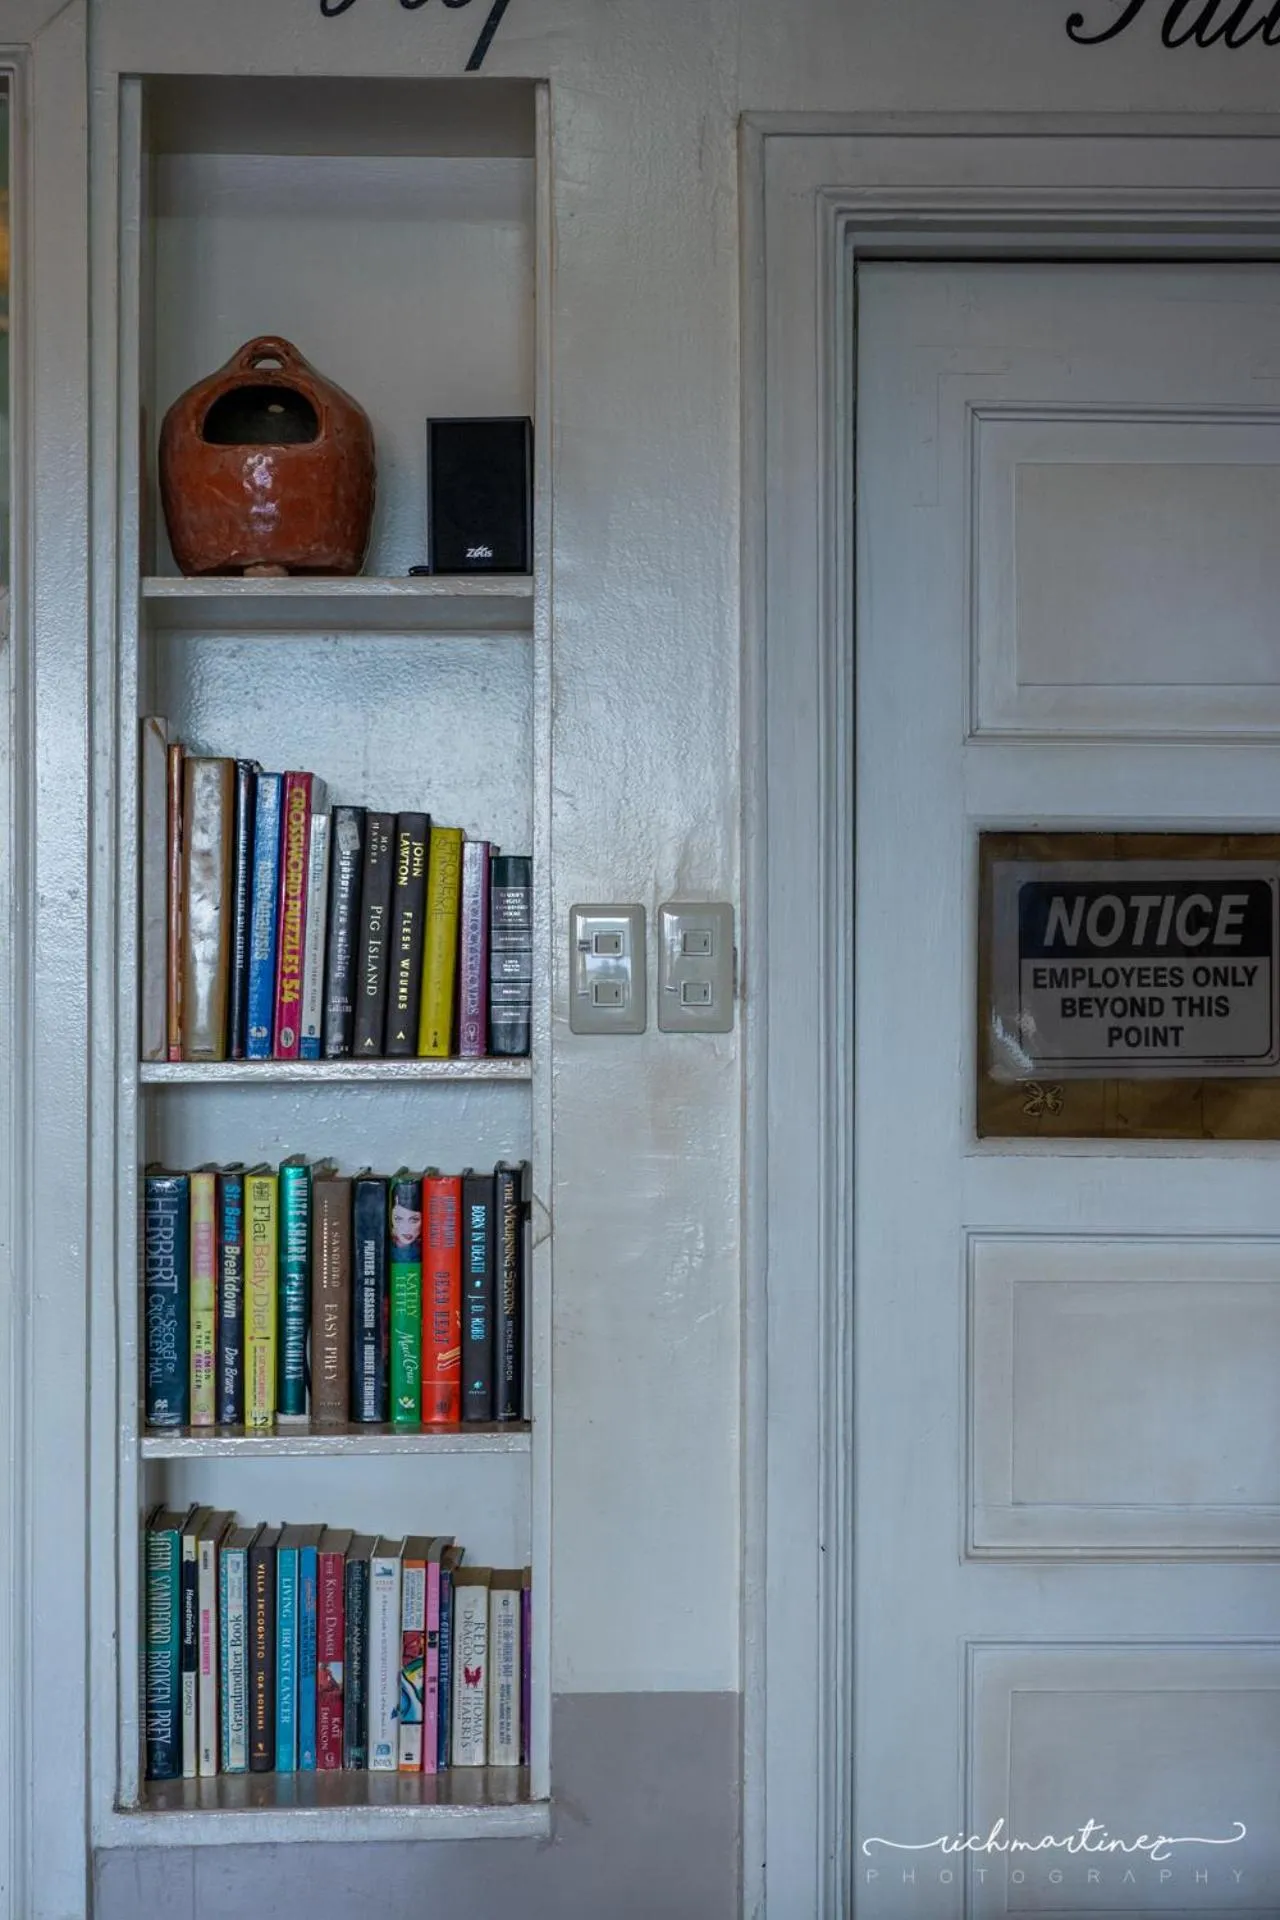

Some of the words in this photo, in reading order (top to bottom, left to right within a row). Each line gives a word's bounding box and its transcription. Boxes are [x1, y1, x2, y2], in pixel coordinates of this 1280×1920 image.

[287, 787, 307, 897] CROSSWORD
[397, 832, 411, 887] LAWTON
[411, 842, 425, 878] JOHN
[282, 899, 302, 974] PUZZLES
[402, 912, 413, 950] FLESH
[1043, 894, 1249, 948] NOTICE
[280, 979, 300, 1003] 54
[397, 958, 412, 1010] WOUNDS
[1032, 966, 1185, 989] EMPLOYEES
[1192, 965, 1259, 988] ONLY
[1060, 996, 1165, 1019] BEYOND
[1172, 996, 1231, 1018] THIS
[1107, 1026, 1185, 1048] POINT
[287, 1177, 308, 1216] WHITE
[224, 1206, 242, 1243] Barts
[252, 1204, 271, 1241] Flat
[471, 1205, 486, 1229] BORN
[502, 1204, 517, 1267] MOURNING
[146, 1197, 179, 1295] HERBERT
[287, 1222, 307, 1263] SHARK
[471, 1232, 486, 1242] IN
[249, 1243, 272, 1290] Belly
[471, 1244, 486, 1273] DEATH
[223, 1245, 242, 1319] Breakdown
[406, 1272, 419, 1319] KATHY
[146, 1293, 166, 1353] CRICKLEY
[204, 1330, 212, 1346] THE
[324, 1303, 339, 1339] EASY
[471, 1317, 486, 1340] ROBB
[158, 1320, 179, 1362] SECRET
[195, 1334, 203, 1350] THE
[224, 1346, 240, 1365] Don
[285, 1317, 304, 1380] BENCHLEY
[149, 1356, 163, 1389] HALL
[195, 1353, 203, 1391] FREEZER
[204, 1350, 212, 1381] DEMON
[324, 1346, 338, 1381] PREY
[148, 1537, 172, 1571] JOHN
[257, 1562, 265, 1594] VILLA
[148, 1575, 172, 1645] SANDFORD
[281, 1577, 293, 1619] LIVING
[229, 1614, 244, 1647] Book
[257, 1598, 265, 1660] INCOGNITO
[325, 1616, 338, 1656] DAMSEL
[462, 1610, 475, 1667] DRAGON
[474, 1621, 487, 1656] RED
[281, 1627, 293, 1673] BREAST
[148, 1650, 172, 1704] BROKEN
[229, 1649, 244, 1733] Grandmother
[280, 1675, 292, 1724] CANCER
[473, 1688, 485, 1745] THOMAS
[147, 1709, 172, 1744] PREY
[320, 1706, 331, 1751] EMERSON
[331, 1716, 342, 1739] KATE
[461, 1696, 473, 1749] HARRIS
